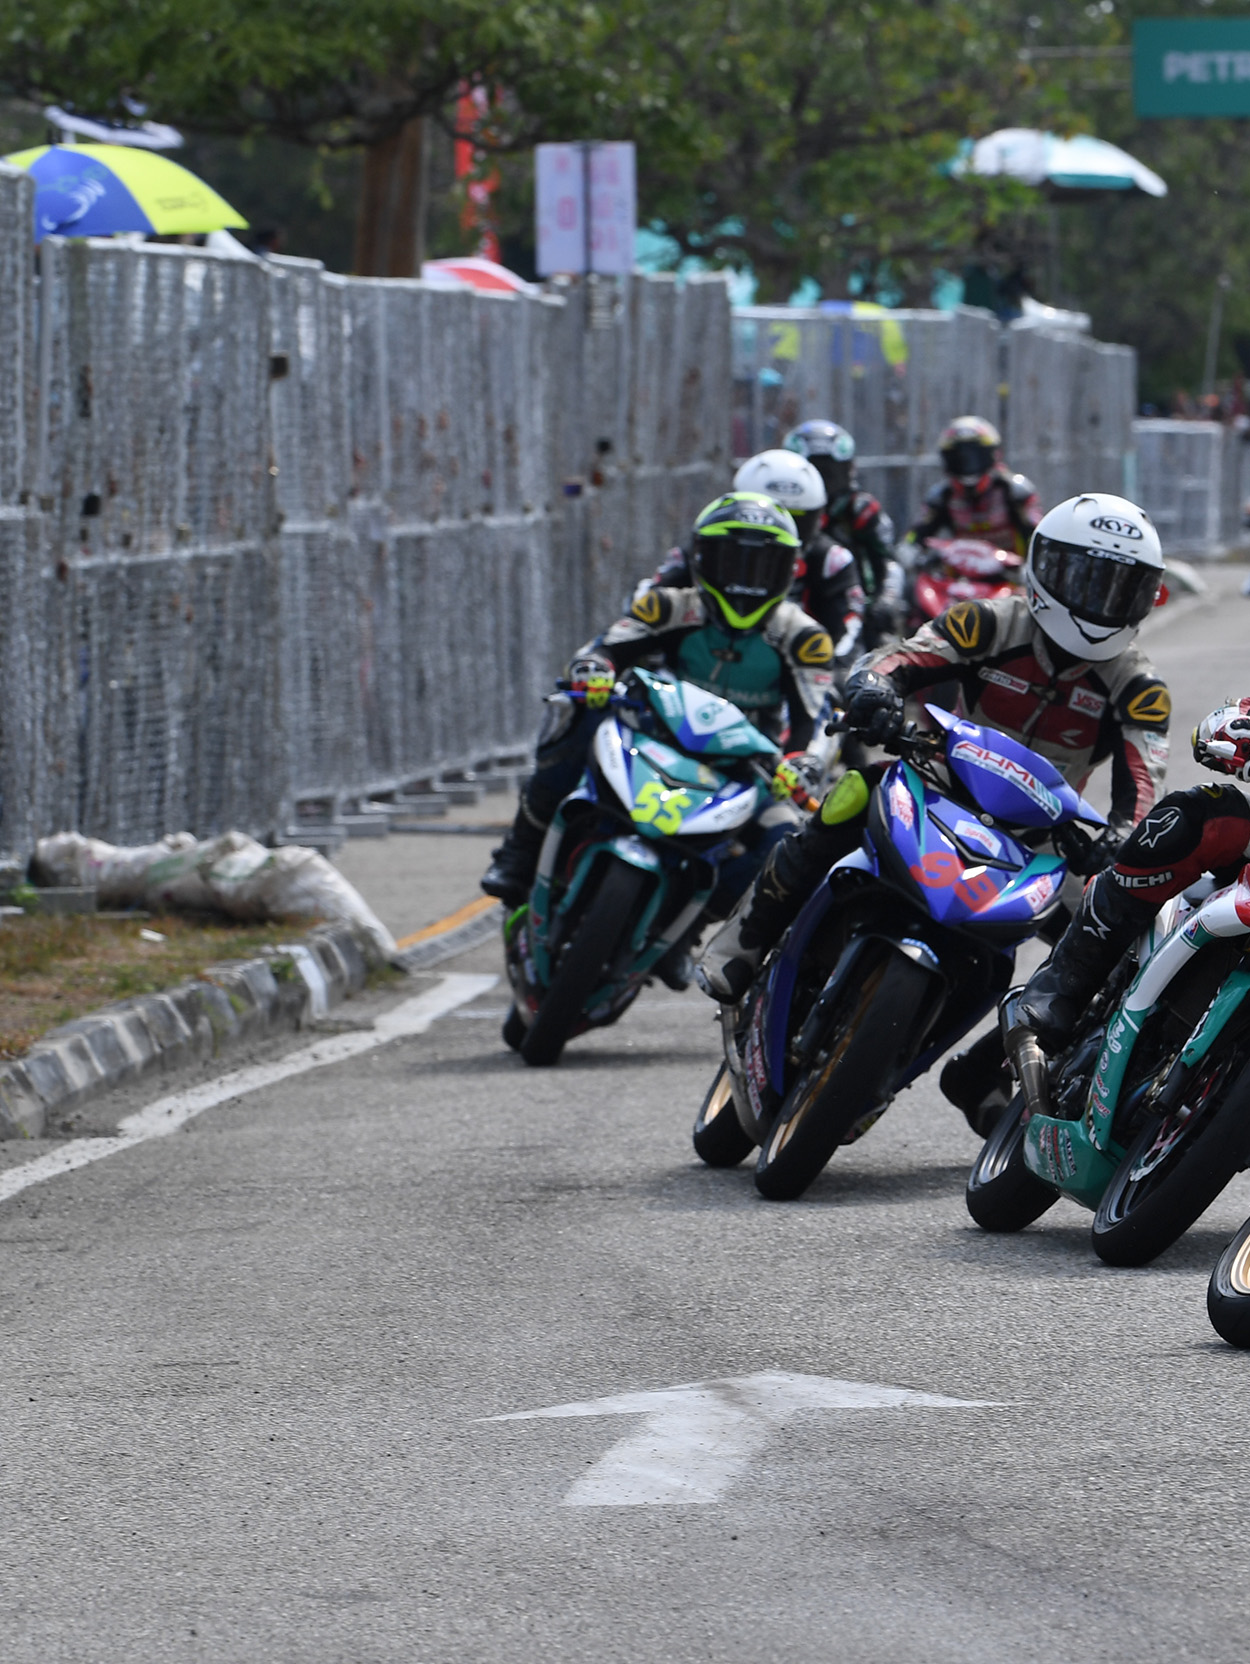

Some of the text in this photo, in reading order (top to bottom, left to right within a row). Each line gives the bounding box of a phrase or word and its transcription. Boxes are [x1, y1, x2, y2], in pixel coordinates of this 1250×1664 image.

[1096, 517, 1138, 536] KYT
[629, 781, 692, 836] 55
[1111, 869, 1173, 888] AICHI
